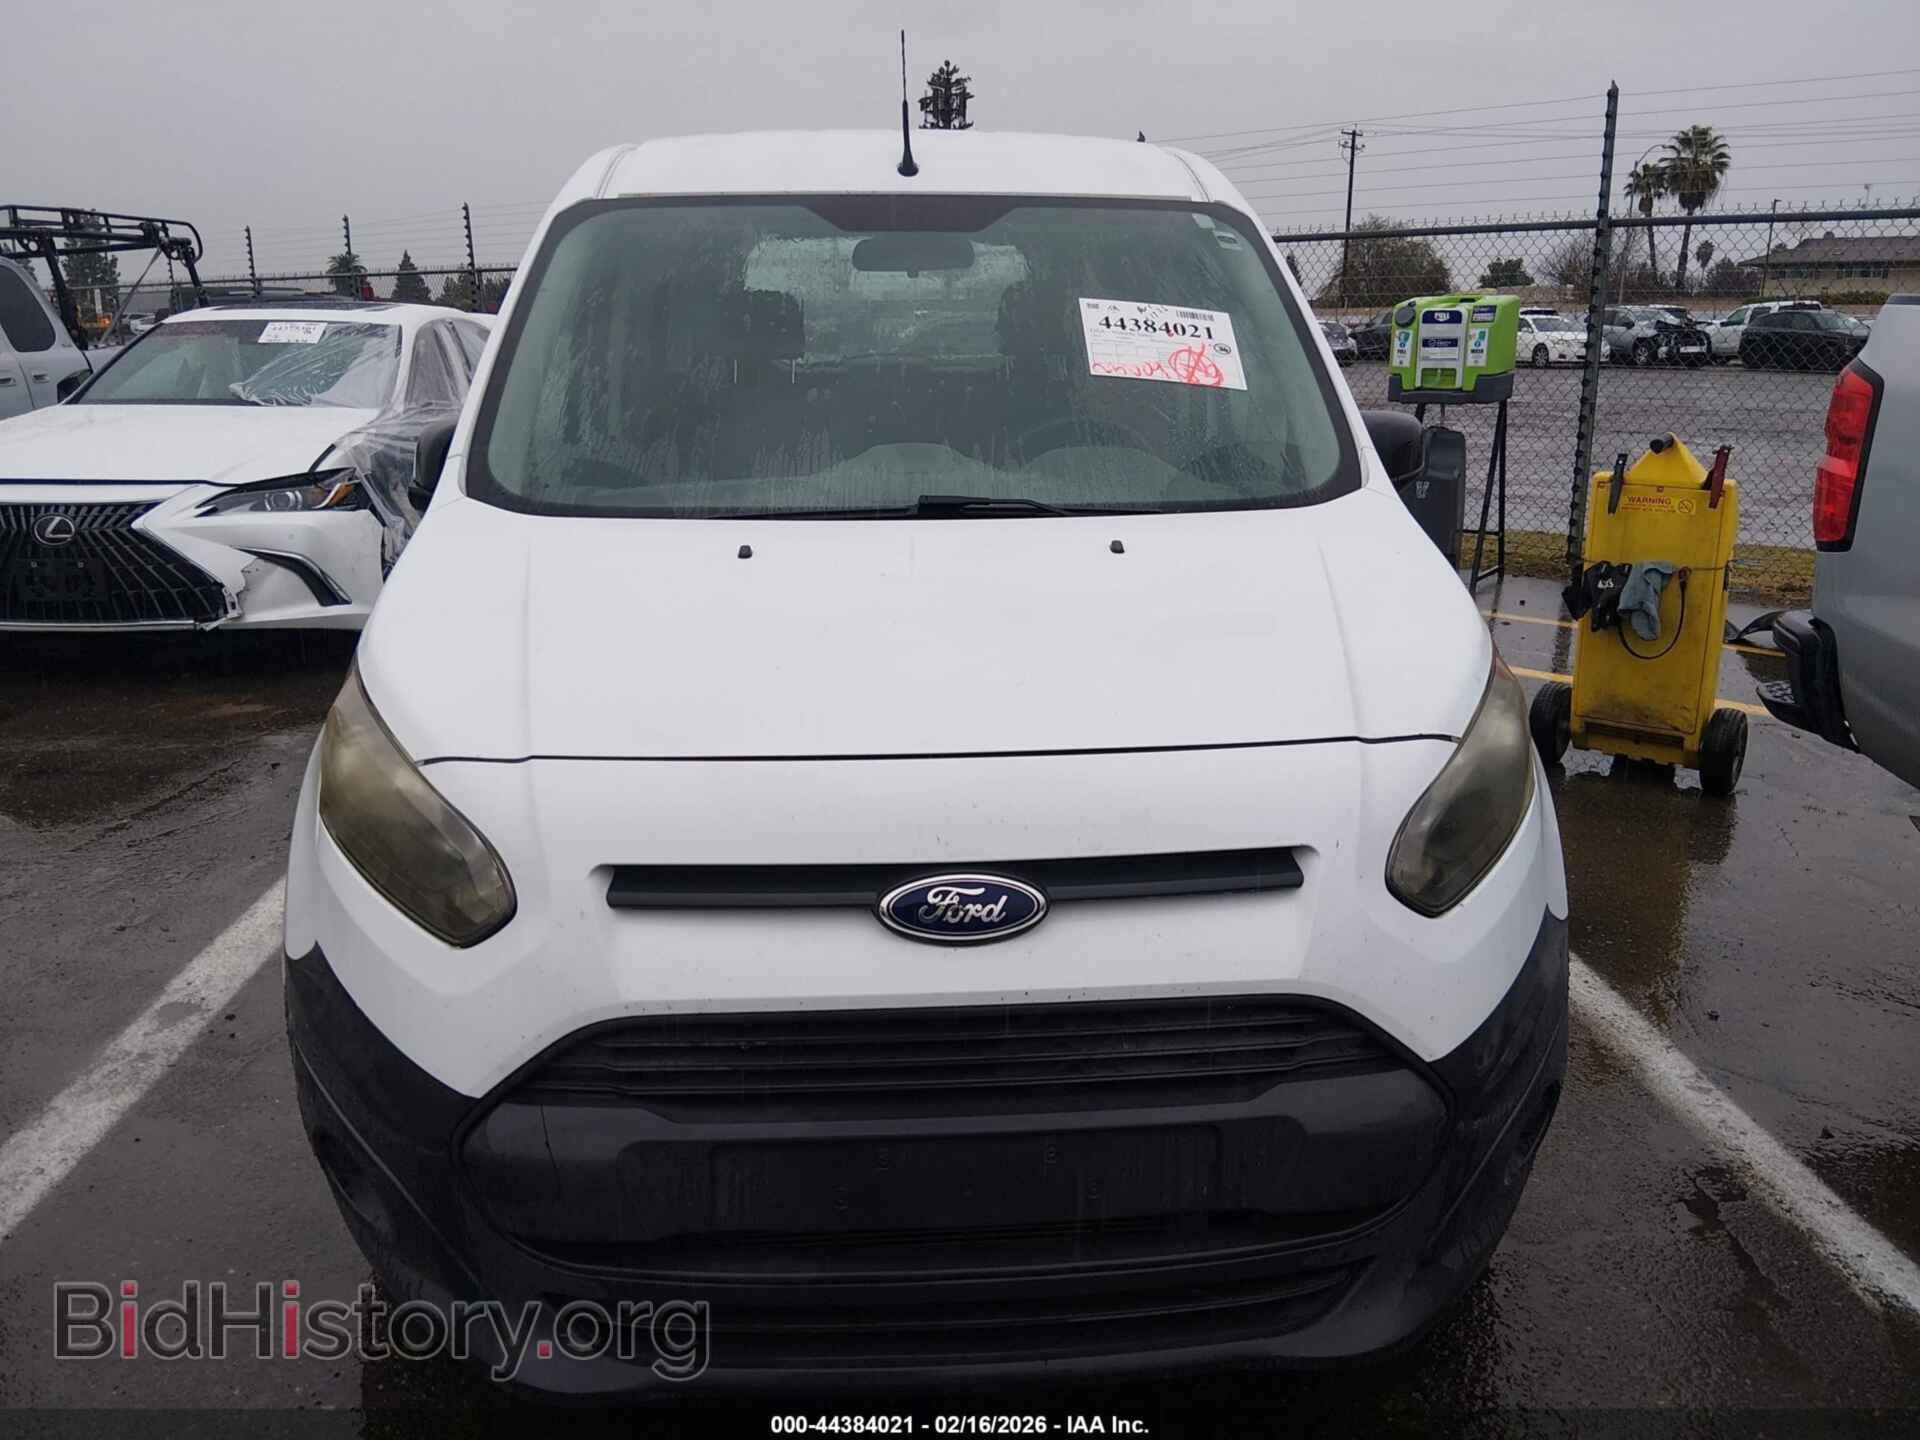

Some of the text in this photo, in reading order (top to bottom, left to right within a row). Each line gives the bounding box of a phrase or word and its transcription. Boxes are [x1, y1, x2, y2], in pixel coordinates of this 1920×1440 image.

[1098, 315, 1214, 340] 44384021
[1628, 495, 1672, 505] WARNING
[918, 886, 1009, 924] Ford
